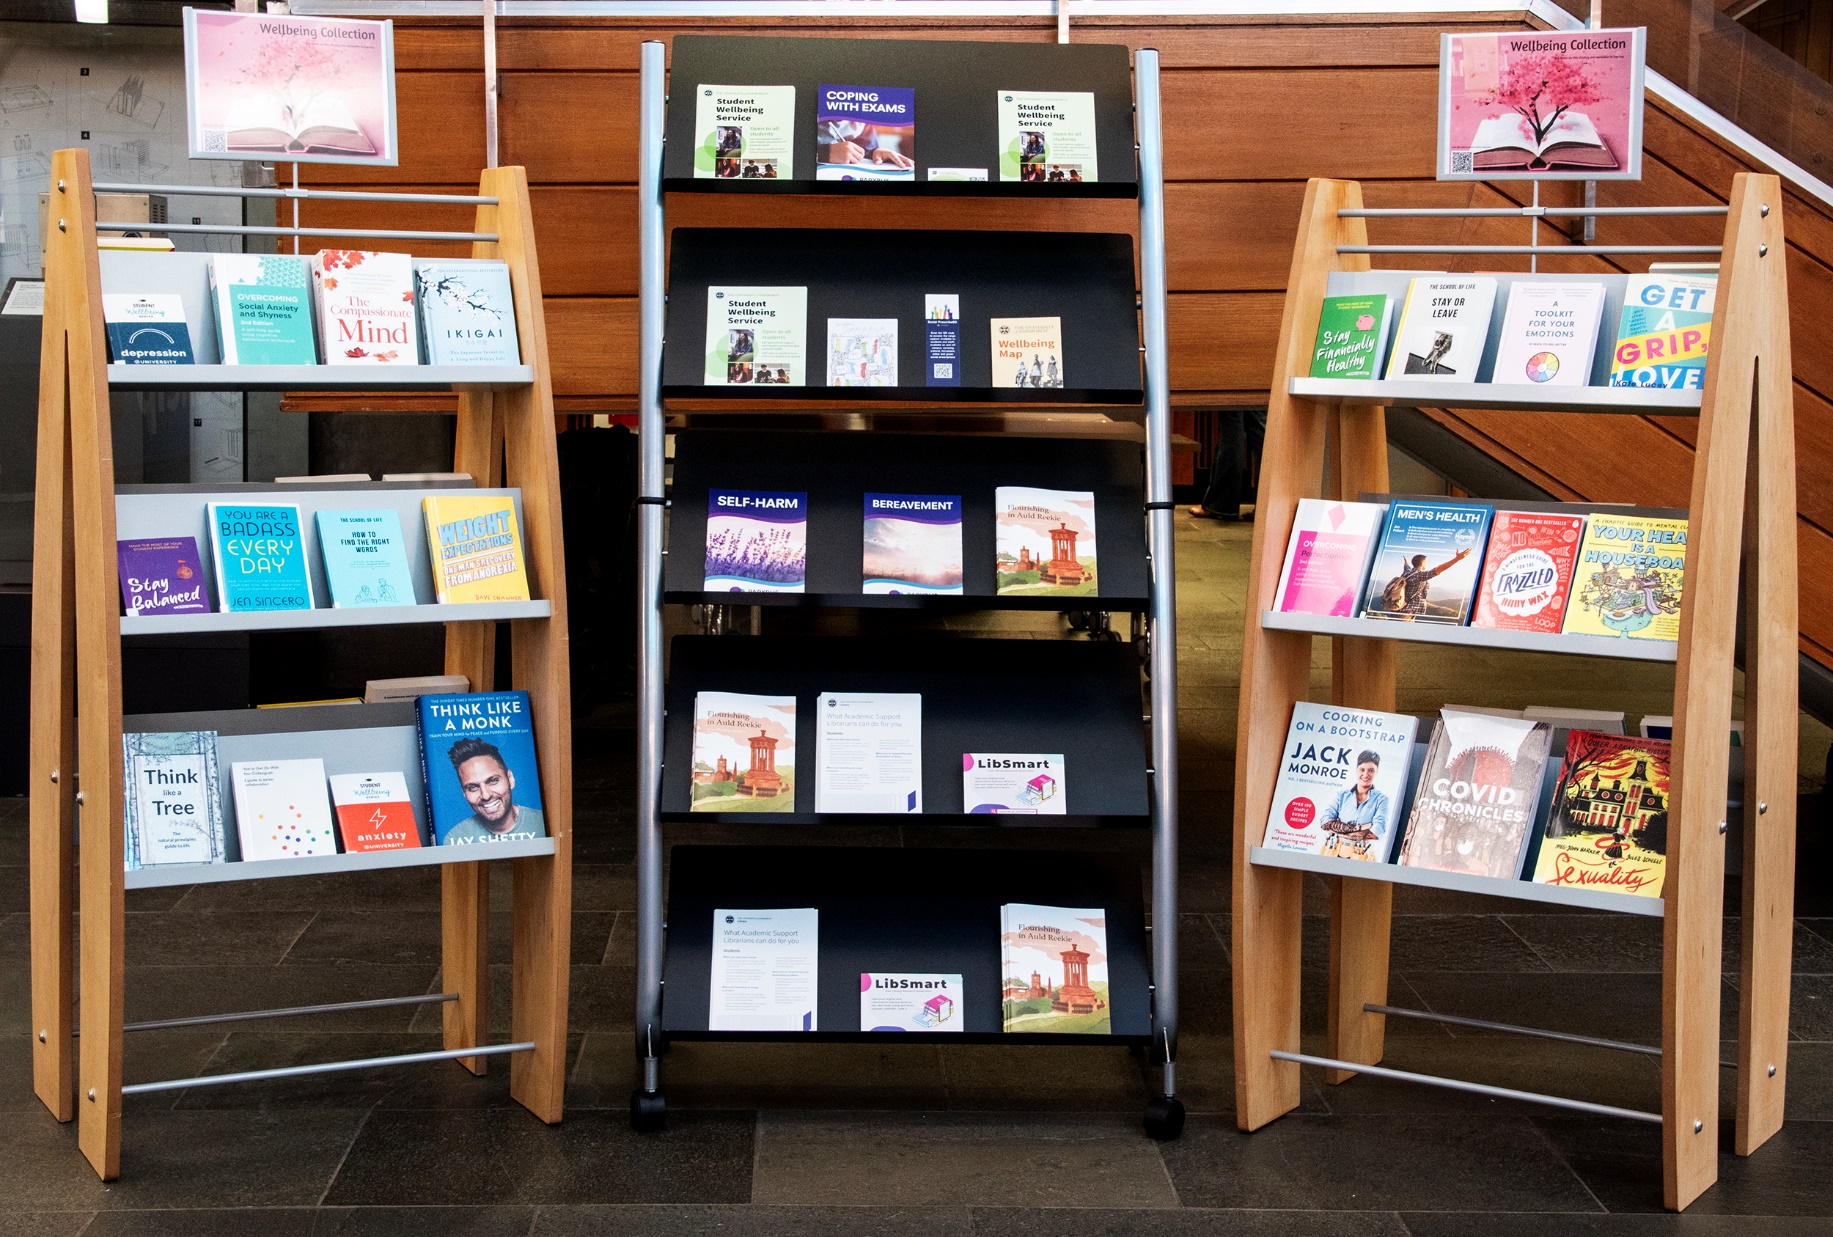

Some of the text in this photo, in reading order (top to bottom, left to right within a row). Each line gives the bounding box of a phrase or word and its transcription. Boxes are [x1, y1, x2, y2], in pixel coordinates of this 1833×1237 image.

[260, 23, 375, 40] Wellbeing Collection
[1511, 38, 1626, 53] Wellbeing Collection
[826, 91, 879, 102] COPING
[716, 106, 764, 114] Wellbeing
[826, 101, 906, 114] WITH EXAMS
[1017, 112, 1065, 120] Wellbeing
[237, 294, 299, 303] OVERCOMING
[346, 295, 370, 307] The
[1431, 298, 1466, 306] STAY OR
[1640, 284, 1706, 310] GET
[258, 311, 292, 319] Shyness
[267, 304, 299, 312] Anxiety
[331, 304, 412, 318] Compassionate
[728, 309, 776, 317] Wellbeing
[1432, 309, 1458, 318] LEAVE
[1550, 320, 1575, 328] YOUR
[1653, 311, 1676, 332] A
[337, 318, 408, 344] Mind
[447, 329, 503, 339] IKIGAI
[1323, 331, 1351, 345] Stay
[1525, 330, 1575, 338] EMOTIONS
[999, 339, 1055, 349] Wellbeing
[1316, 334, 1375, 361] Financially
[1616, 330, 1708, 365] GRIP,
[121, 349, 186, 358] depression
[999, 350, 1023, 360] Map
[1327, 352, 1366, 373] Healthy
[1616, 365, 1701, 389] LOVE
[1640, 381, 1668, 389] Lucey
[717, 495, 798, 509] SELF-HARM
[872, 499, 953, 511] BEREAVEMENT
[1007, 504, 1050, 514] Flourishing
[225, 510, 289, 520] YOU ARE A
[1017, 512, 1035, 520] Auld
[1037, 513, 1062, 521] Reekie
[1397, 509, 1480, 523] MEN'S HEALTH
[221, 522, 296, 537] BADASS
[438, 509, 511, 546] WEIGHT
[1593, 525, 1687, 545] YOUR HEA
[227, 539, 294, 556] EVERY
[442, 533, 513, 560] EXPECTATIONS
[1303, 540, 1357, 552] OVERCOMING
[1631, 543, 1655, 554] IS A
[1301, 550, 1352, 560] Perfectionism
[1505, 554, 1535, 568] MINDFULNESS
[1536, 555, 1549, 564] GUIDE
[1585, 550, 1684, 570] HOUSEBOA
[240, 558, 285, 574] DAY
[444, 551, 516, 576] ONE MAN'S RECOVERY
[445, 562, 518, 588] FROM ANOREXIA
[1496, 568, 1554, 594] FRAZZLED
[127, 578, 169, 593] Stay
[131, 585, 200, 610] Balanced
[232, 596, 305, 606] JEN SINCERO
[1501, 591, 1550, 608] RUBY WAX
[1534, 617, 1557, 628] LOOP
[431, 701, 521, 717] THINK LIKE
[707, 710, 750, 721] Flourishing
[445, 716, 512, 731] A MONK
[716, 719, 735, 727] Auld
[737, 720, 762, 729] Reekie
[1323, 711, 1384, 727] COOKING
[1296, 721, 1406, 744] ON A BOOTSTRAP
[1291, 742, 1352, 766] JACK
[978, 758, 1050, 769] LibSmart
[144, 768, 199, 785] Think
[1288, 762, 1348, 780] MONROE
[1433, 778, 1517, 805] COVID
[152, 800, 195, 816] Tree
[1418, 797, 1524, 822] CHRONICLES
[358, 832, 406, 841] anxiety
[1545, 852, 1659, 892] Sexuality
[773, 930, 798, 938] Support
[1018, 923, 1060, 935] Flourishing
[1027, 932, 1046, 940] Auld
[1048, 934, 1073, 943] Reekie
[875, 978, 948, 989] LibSmart
